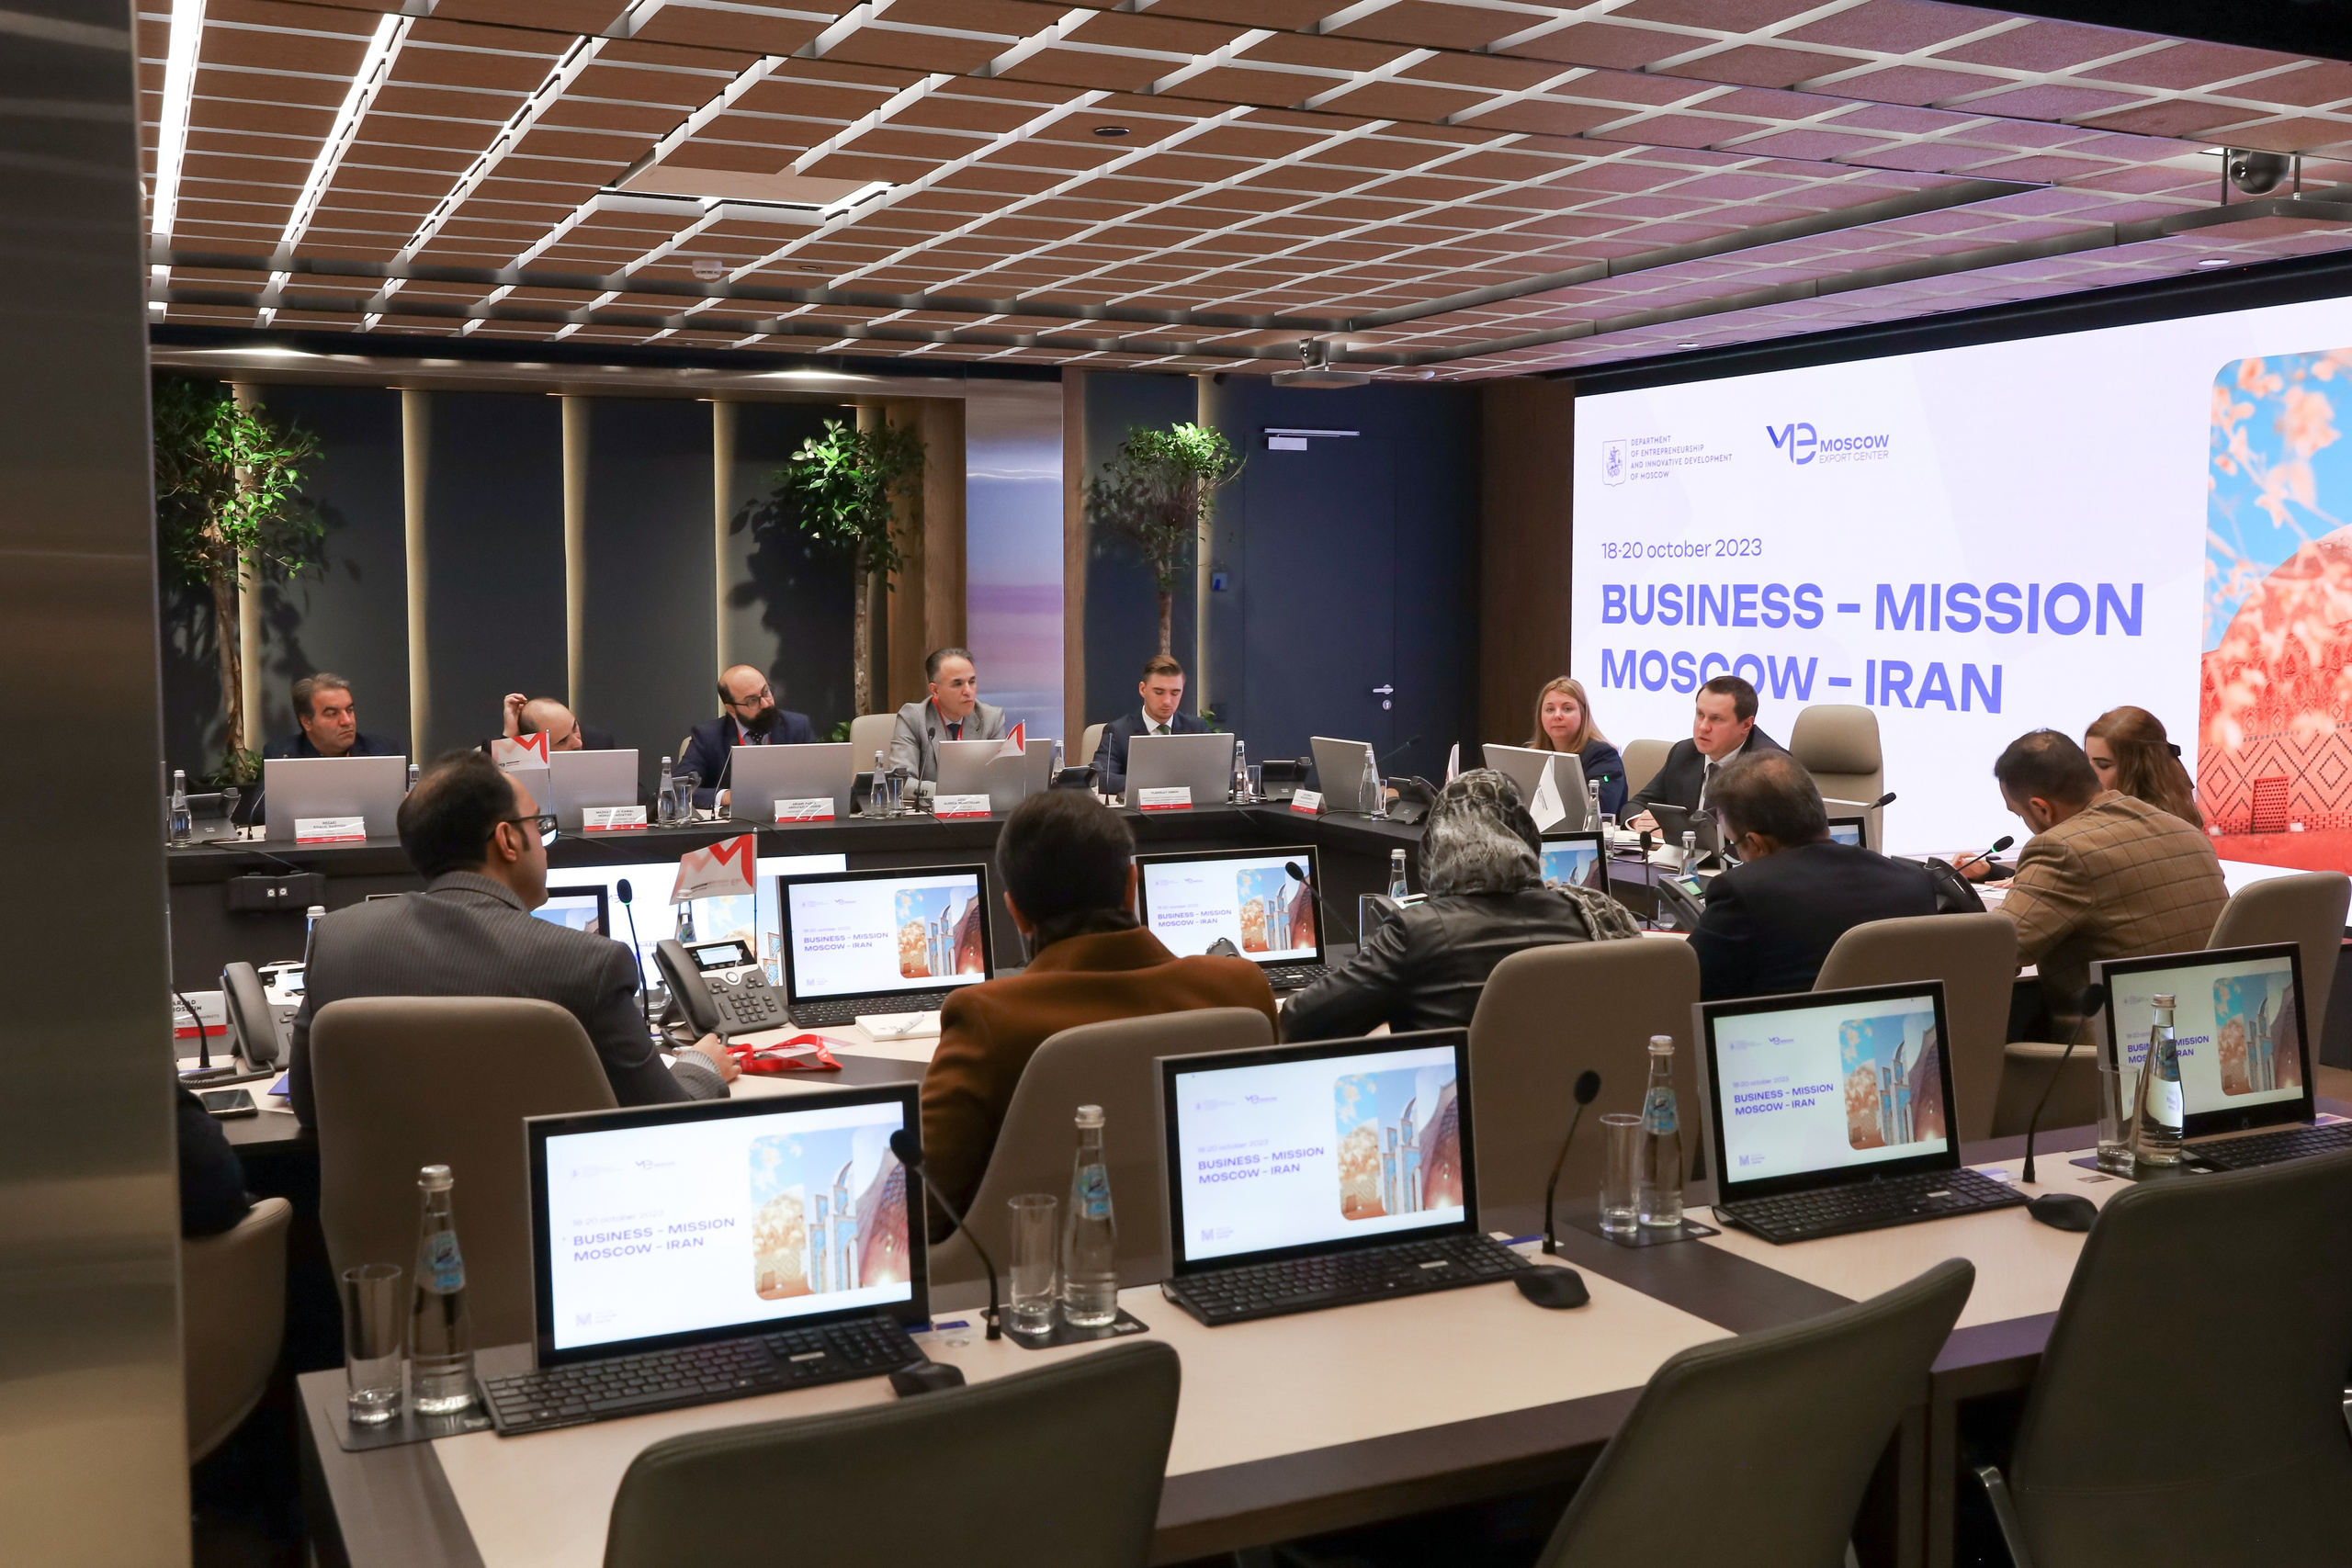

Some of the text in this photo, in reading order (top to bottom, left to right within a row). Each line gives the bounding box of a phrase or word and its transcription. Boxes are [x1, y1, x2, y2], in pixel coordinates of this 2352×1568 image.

[1631, 435, 1671, 446] DEPARTMENT
[1820, 434, 1890, 452] MOSCOW
[1640, 444, 1704, 457] ENTREPRENEURSHIP
[1819, 450, 1889, 464] EXPORT CENTER
[1630, 454, 1733, 468] AND INNOVATIVE DEVELOPMENT
[1630, 470, 1669, 480] OF MOSCOW
[1647, 540, 1712, 558] october
[1714, 537, 1762, 557] 2023
[1601, 582, 1824, 629] BUSINESS
[1875, 581, 2143, 636] MISSION
[1865, 659, 2002, 714] IRAN
[804, 935, 845, 943] BUSINESS
[805, 943, 845, 952] MOSCOW
[2175, 1035, 2209, 1045] MISSION
[2176, 1048, 2194, 1057] RAN
[1734, 1089, 1783, 1103] BUSINESS
[1792, 1084, 1834, 1096] MISSION
[1735, 1102, 1783, 1115] MOSCOW
[1792, 1099, 1815, 1108] IRAN
[1198, 1154, 1261, 1170] BUSINESS
[1272, 1146, 1324, 1161] MISSION
[1198, 1168, 1260, 1184] MOSCOW
[1271, 1163, 1300, 1175] IRAN
[573, 1227, 653, 1247] BUSINESS
[668, 1218, 735, 1235] MISSION
[574, 1243, 652, 1262] MOSCOW
[666, 1237, 704, 1250] IRAN
